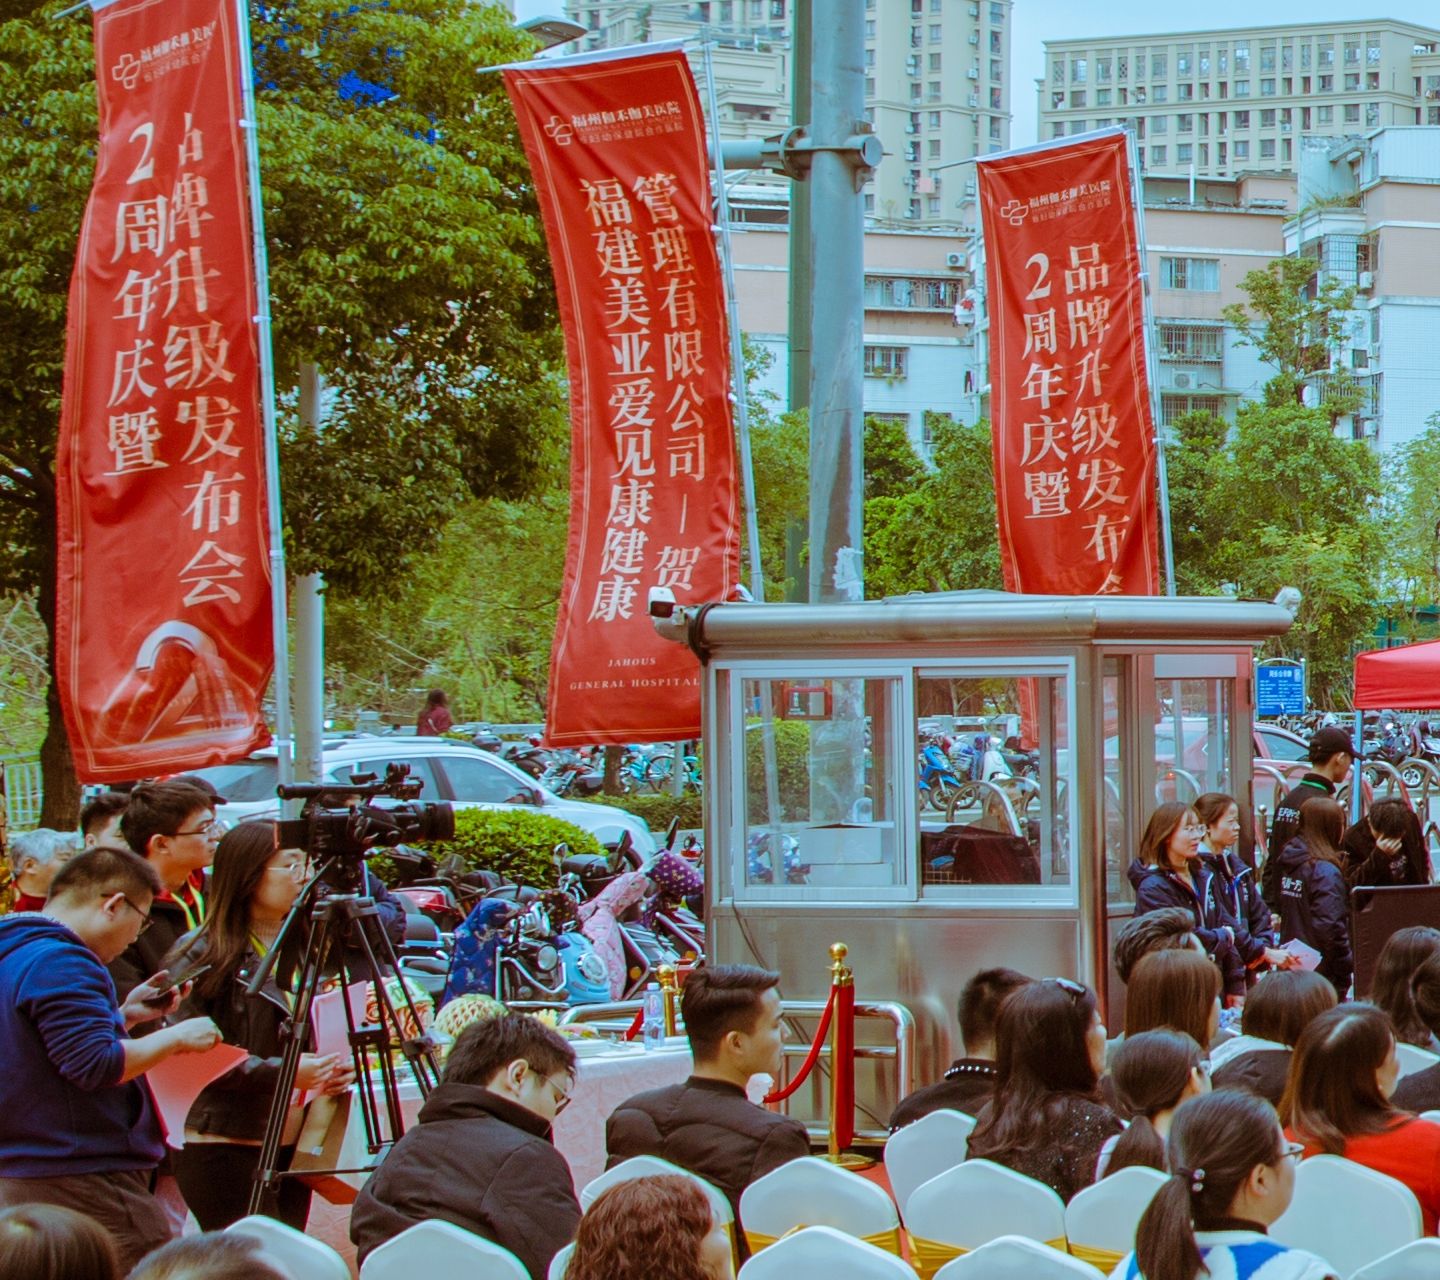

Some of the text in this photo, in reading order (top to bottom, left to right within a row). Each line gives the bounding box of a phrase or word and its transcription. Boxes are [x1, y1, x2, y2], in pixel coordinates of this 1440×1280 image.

[103, 122, 169, 476] 2周年庆暨
[579, 177, 656, 623] 福建美亚爱见康健康
[1020, 253, 1071, 519] 2周年庆暨
[569, 678, 700, 690] GENERAL HOSPITAL
[608, 657, 657, 667] JAHOUS
